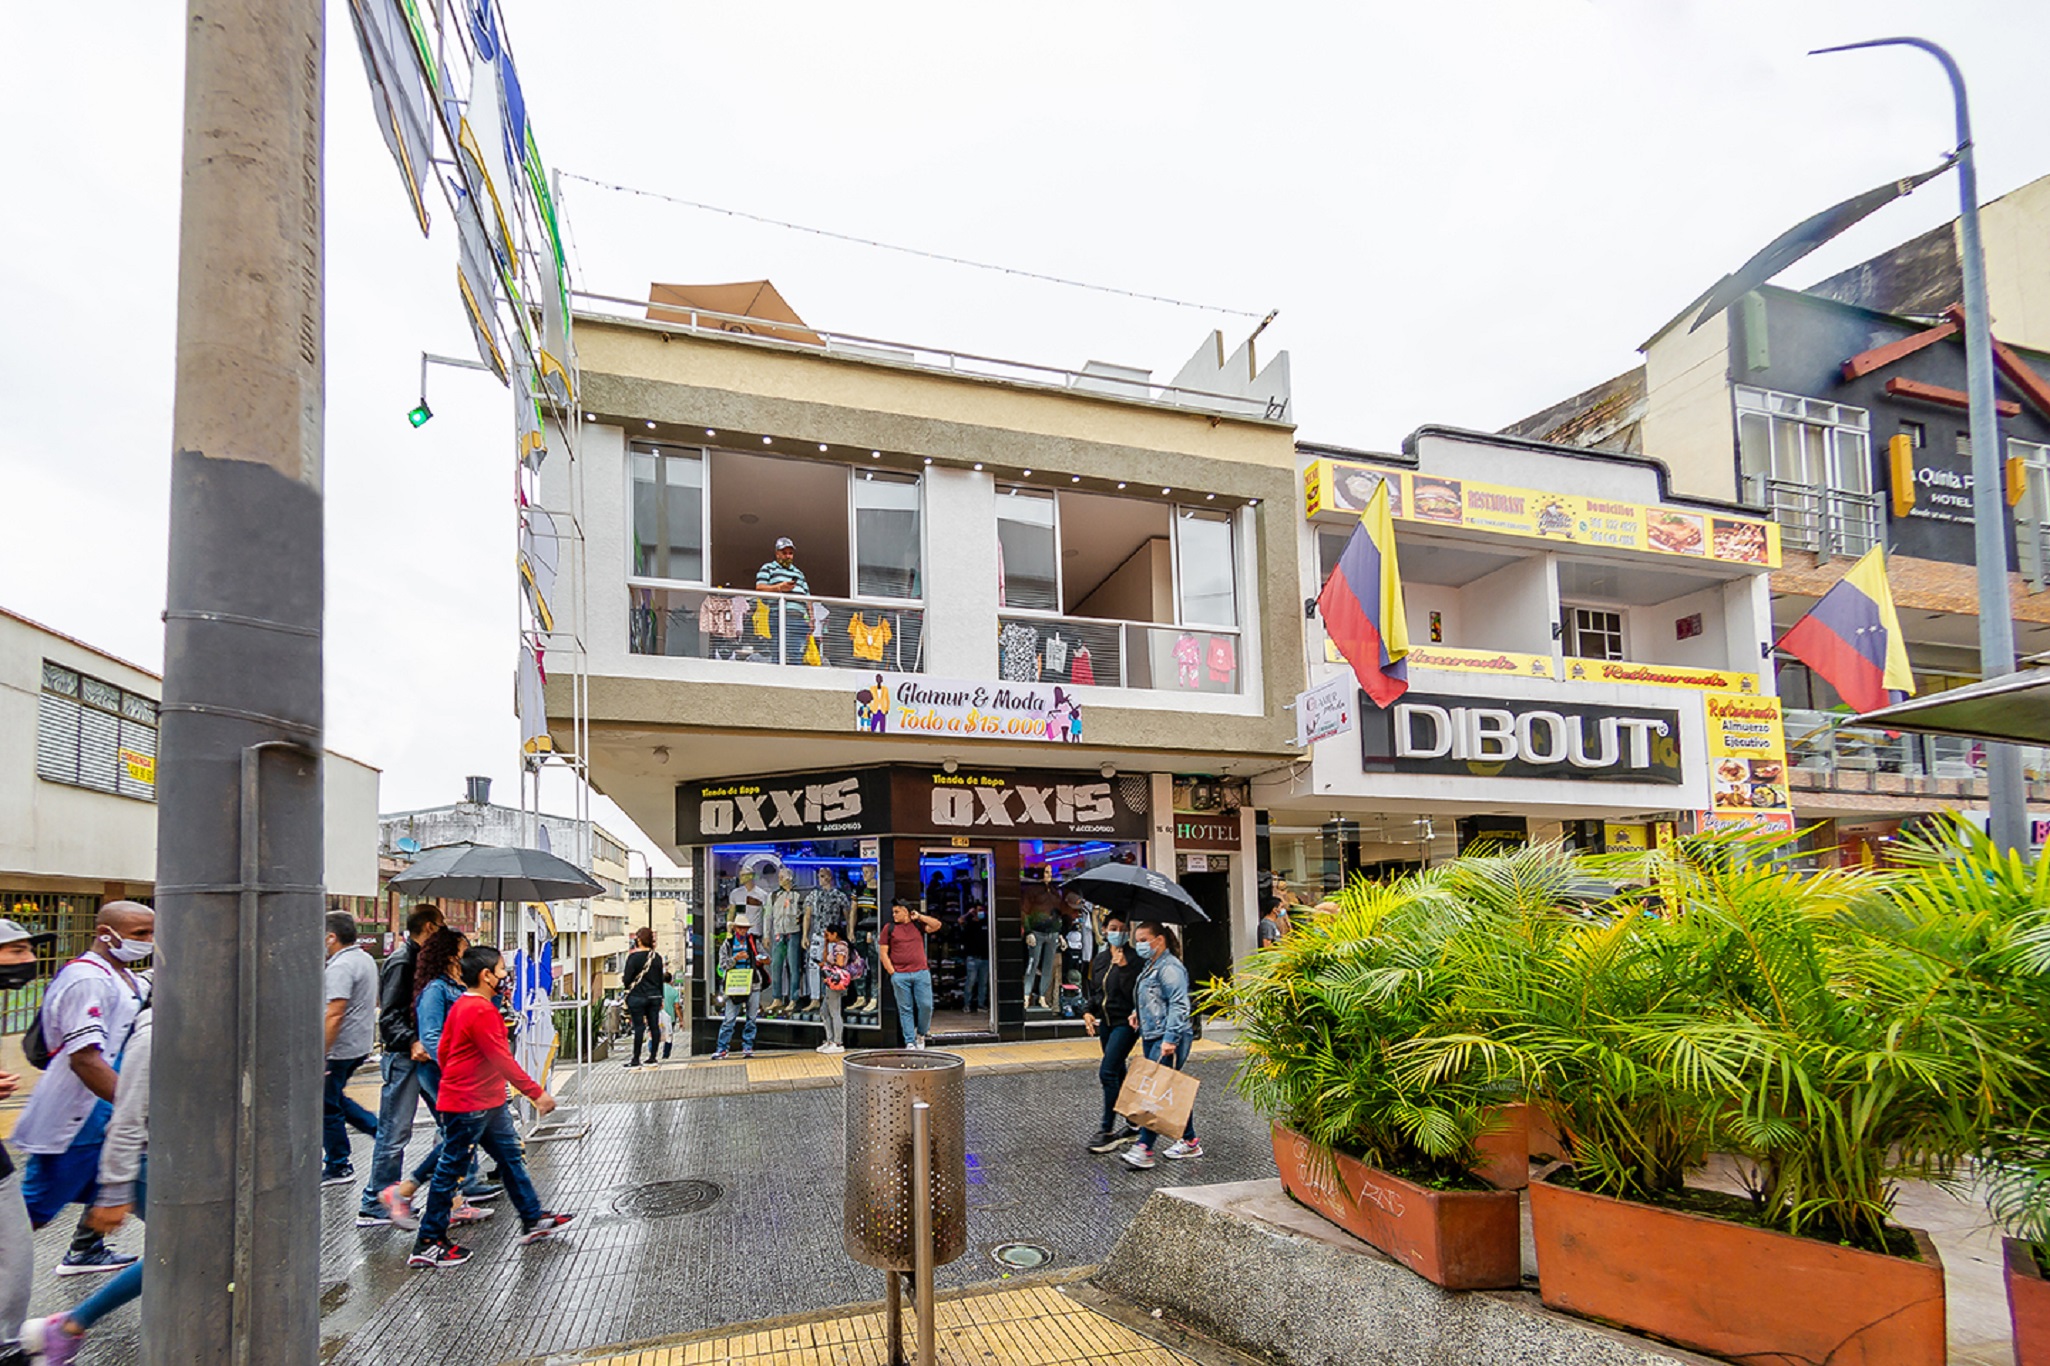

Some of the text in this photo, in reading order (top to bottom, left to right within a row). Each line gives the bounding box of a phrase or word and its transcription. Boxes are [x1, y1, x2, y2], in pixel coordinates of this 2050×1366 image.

[1918, 467, 1963, 489] Quinta
[1930, 493, 1974, 508] HOTEL
[896, 681, 1045, 711] Glamur & Moda
[897, 707, 1046, 737] Todo a $15.000
[1722, 719, 1771, 733] Almuerzo
[1394, 703, 1665, 768] DIBOUT
[1724, 734, 1771, 749] Ejecutivo
[933, 774, 1005, 788] Tienda de Ropa
[700, 777, 863, 835] OXXIS
[931, 783, 1115, 827] OXXIS
[1176, 823, 1240, 841] HOTEL
[1137, 1075, 1174, 1106] ELA
